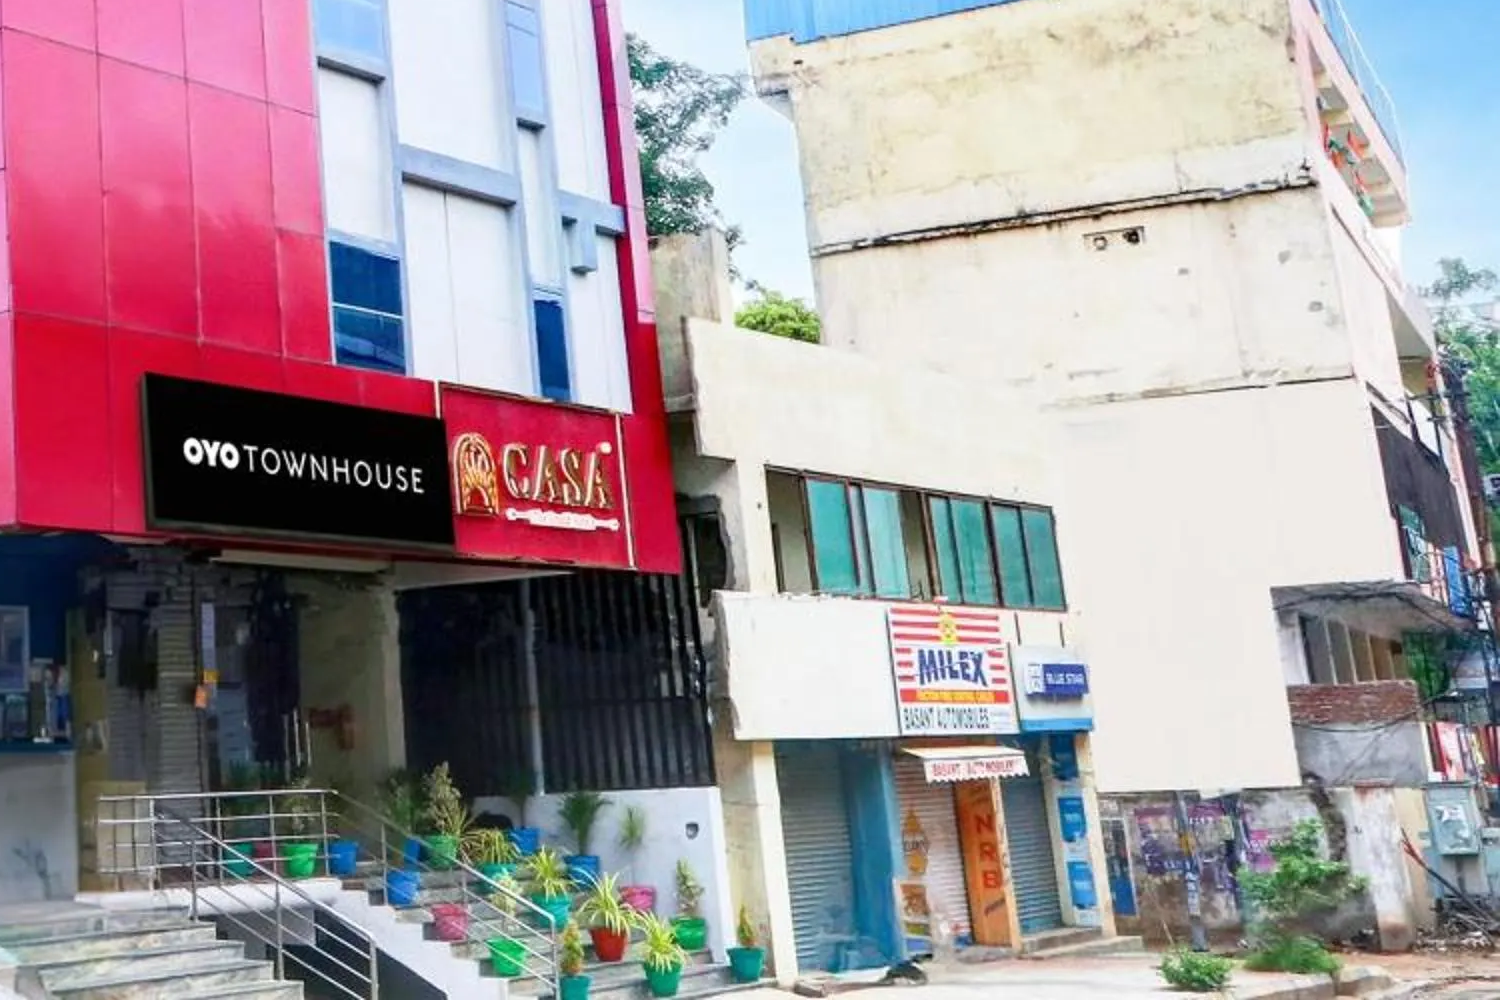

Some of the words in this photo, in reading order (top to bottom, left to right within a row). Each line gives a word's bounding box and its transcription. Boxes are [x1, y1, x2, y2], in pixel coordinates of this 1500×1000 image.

[183, 437, 240, 470] OYO
[242, 444, 425, 494] TOWNHOUSE
[503, 442, 613, 510] CASA
[917, 649, 989, 688] MILEX
